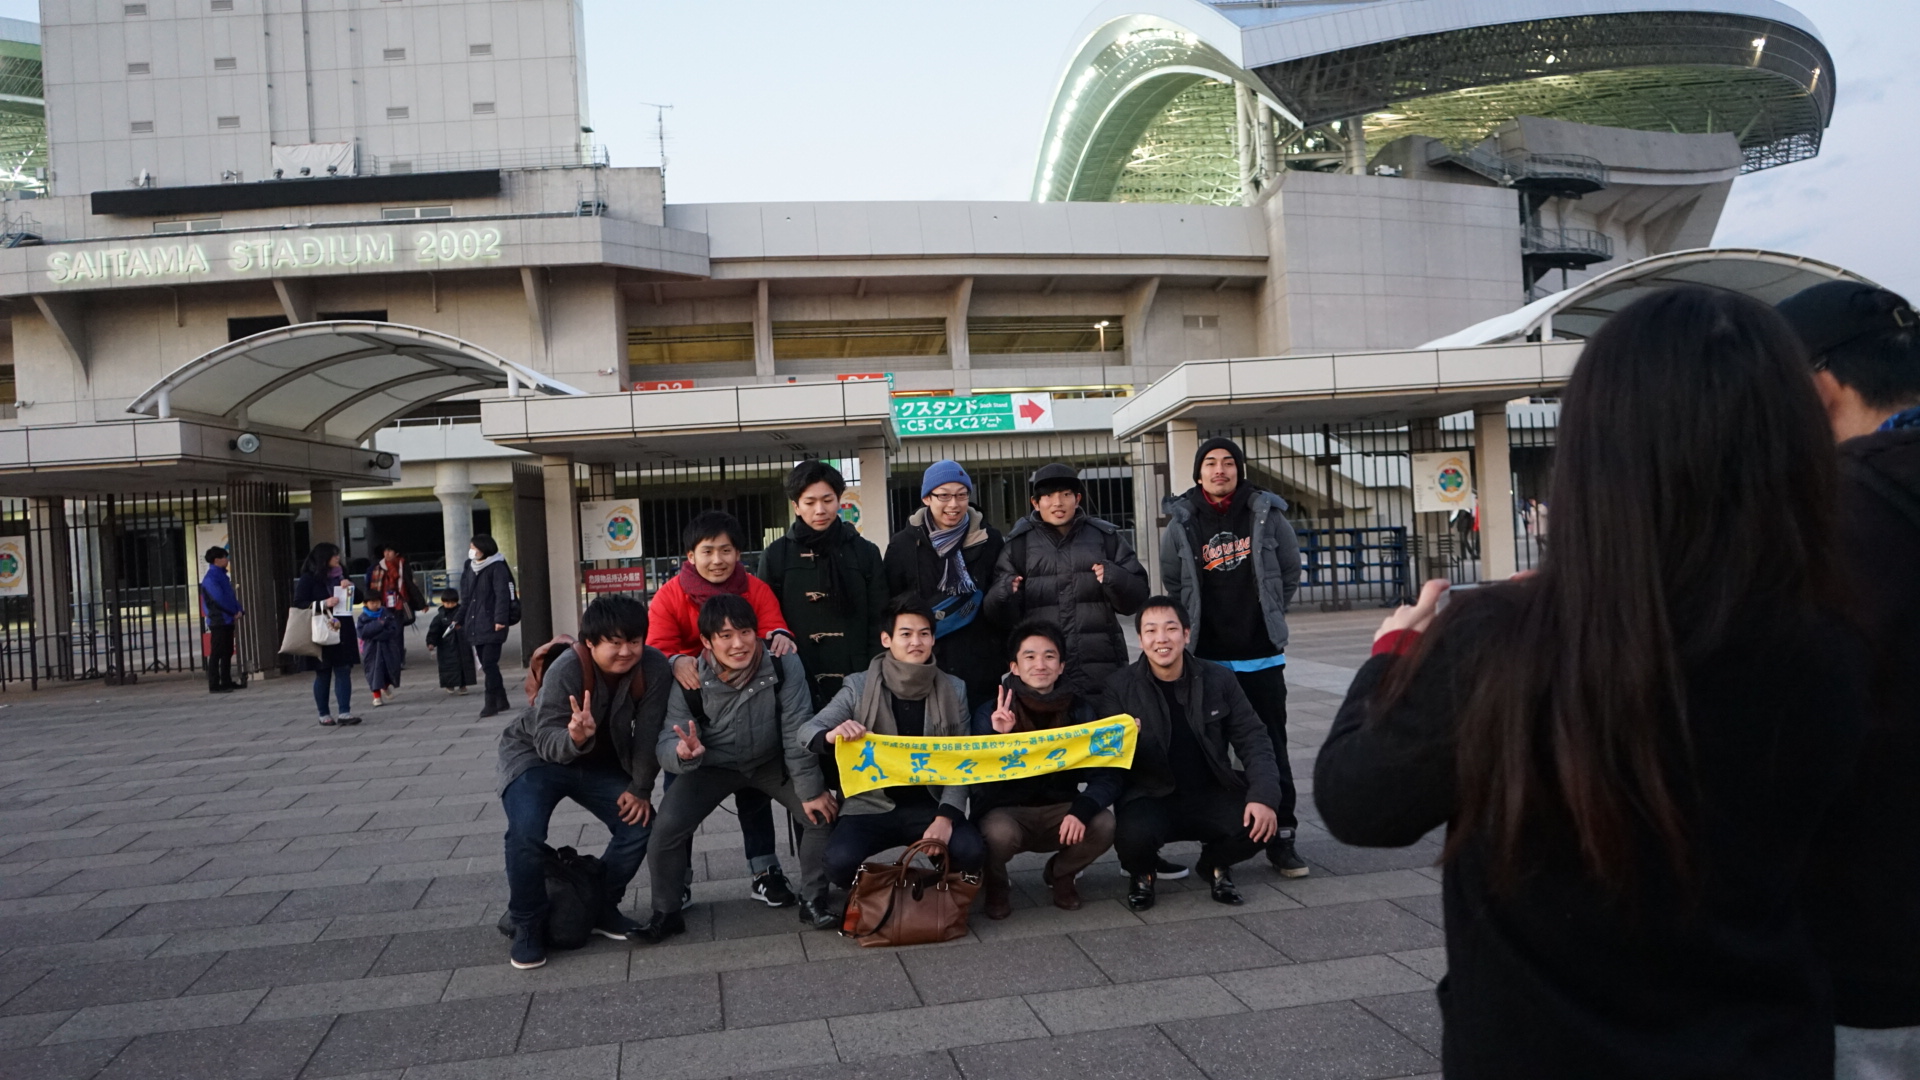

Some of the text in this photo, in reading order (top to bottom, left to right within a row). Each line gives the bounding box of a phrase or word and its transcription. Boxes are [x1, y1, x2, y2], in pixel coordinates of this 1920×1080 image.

[46, 227, 503, 283] SAITAMA STADIUM 2002
[981, 416, 1002, 425] ゲート
